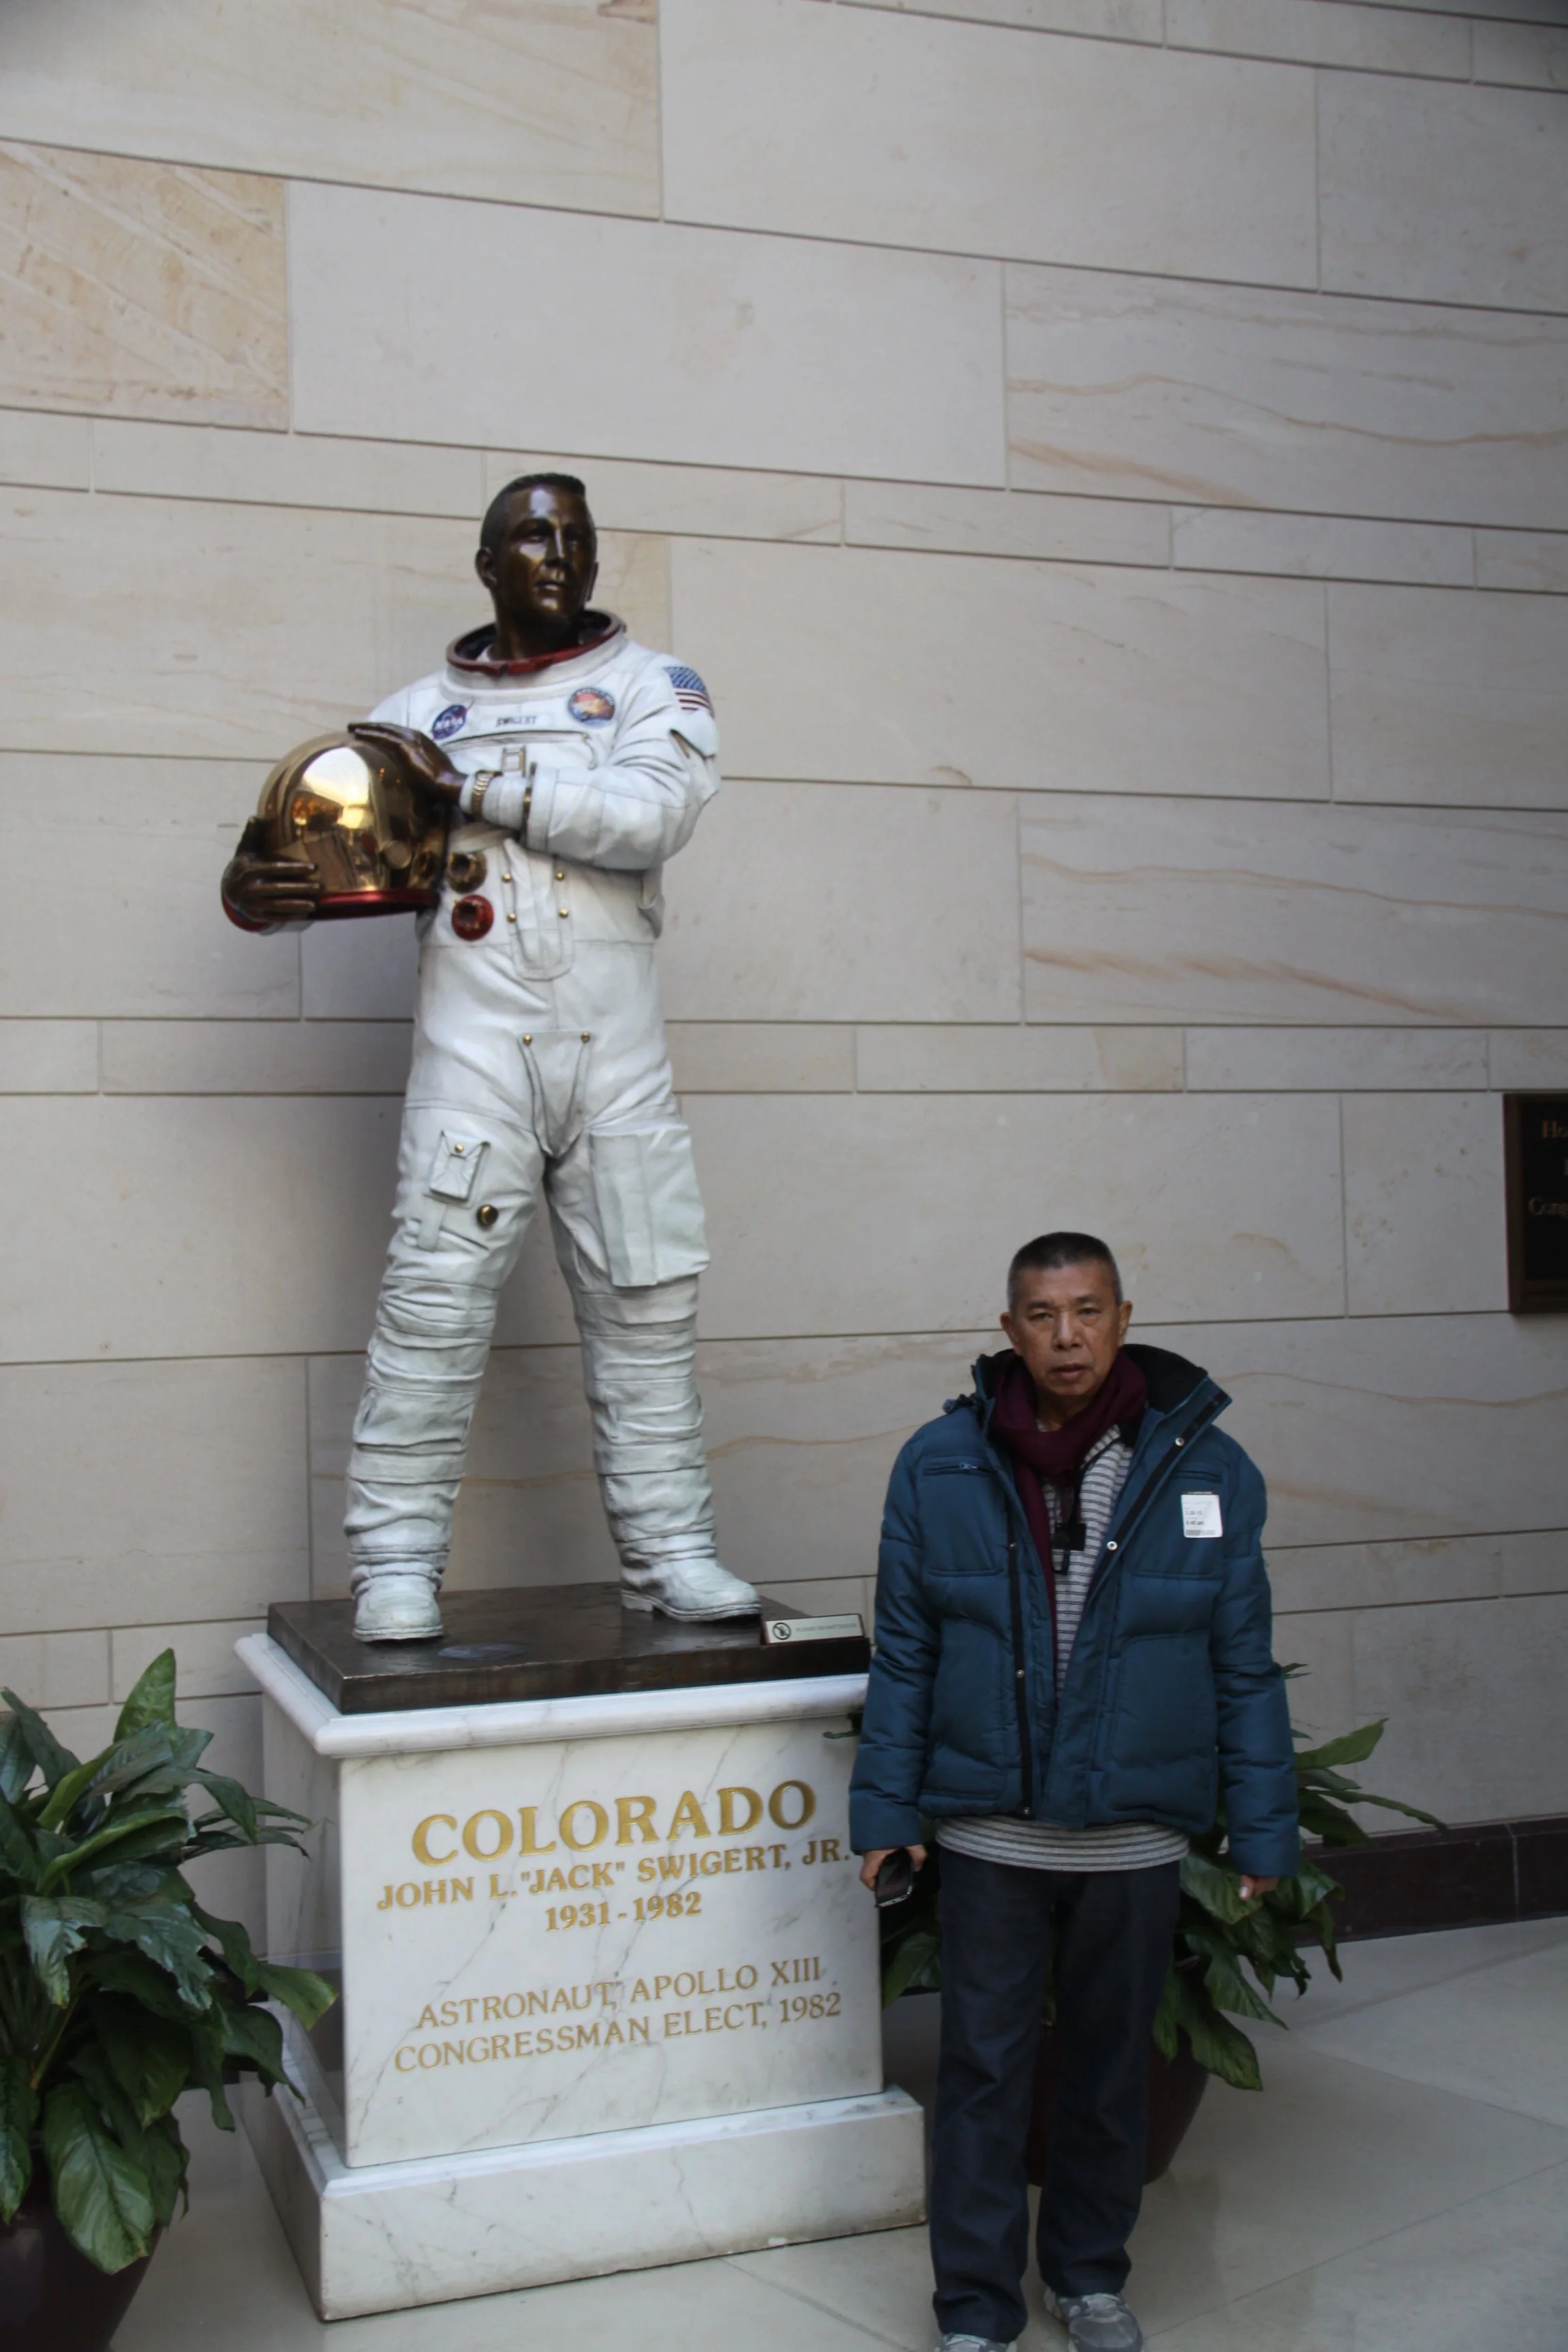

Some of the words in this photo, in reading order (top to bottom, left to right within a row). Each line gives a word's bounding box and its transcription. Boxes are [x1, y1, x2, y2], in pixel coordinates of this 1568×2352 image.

[412, 1780, 815, 1866] COLORADO
[377, 1876, 474, 1911] JOHN
[489, 1874, 517, 1899] L.
[521, 1861, 625, 1895] "JACK"
[637, 1844, 791, 1884] SWIGERT,
[802, 1838, 850, 1866] JR.
[416, 1981, 617, 2029] ASTRONAUT,
[630, 1965, 758, 2003] APOLLO
[770, 1956, 821, 1987] XIII
[394, 2016, 649, 2073] CONGRESSMAN
[664, 2002, 767, 2038] ELECT,
[779, 1991, 842, 2023] 1982
